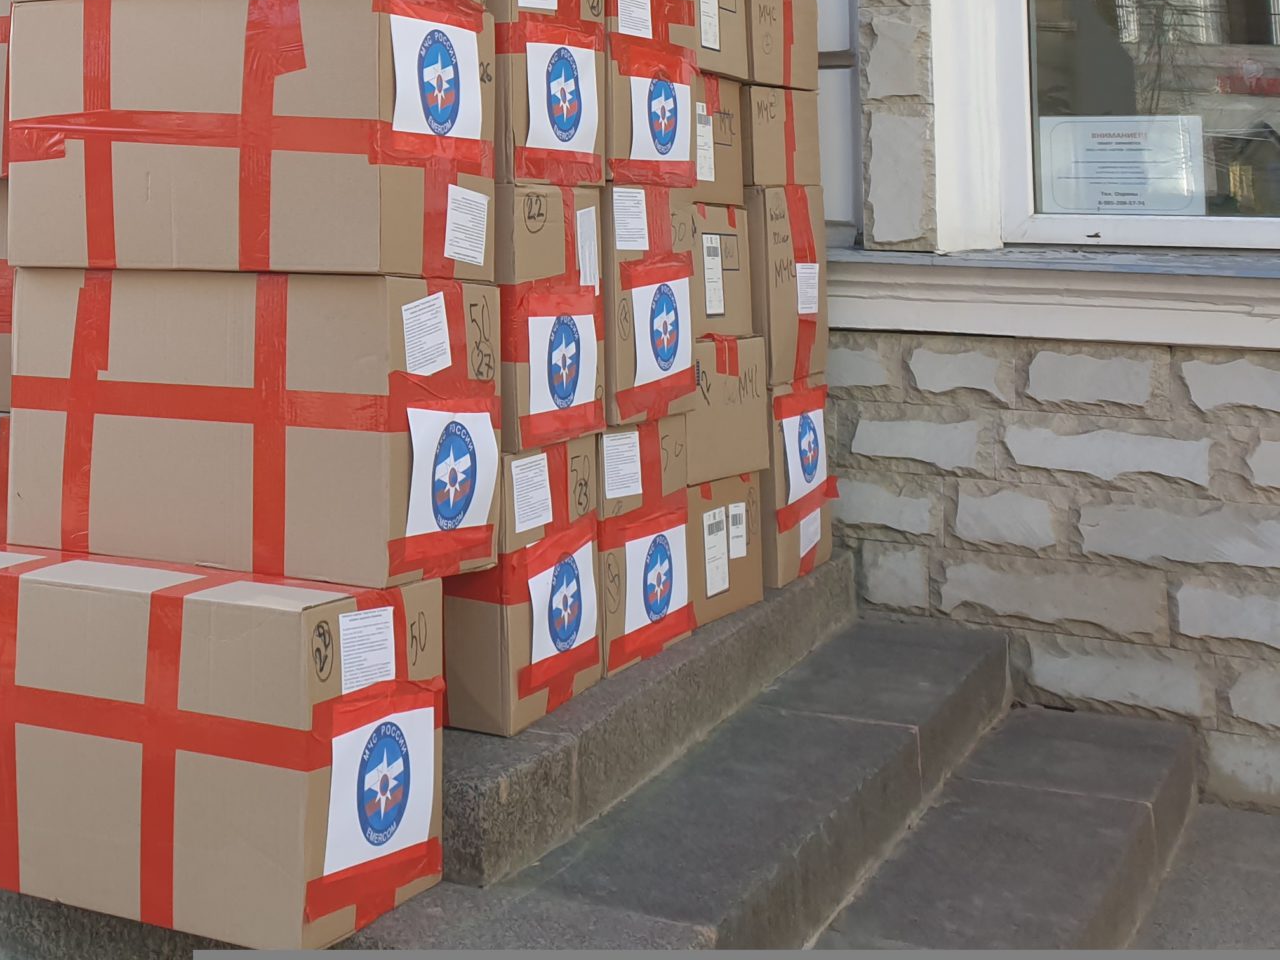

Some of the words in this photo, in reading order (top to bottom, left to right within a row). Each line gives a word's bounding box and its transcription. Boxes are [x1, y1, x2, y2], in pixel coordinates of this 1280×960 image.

[758, 3, 777, 25] МЧС
[420, 35, 433, 58] МЧС
[435, 31, 457, 65] РОССИИ
[480, 61, 493, 84] 26
[547, 53, 558, 73] МЧС
[561, 49, 579, 77] РОССИИ
[756, 100, 776, 120] МЧС
[428, 115, 452, 135] EMERCOM
[554, 124, 576, 142] EMERCOM
[524, 193, 546, 225] 22
[774, 257, 796, 288] МЧС
[470, 295, 491, 350] 50
[549, 319, 559, 341] МЧС
[474, 347, 495, 381] 27
[553, 391, 575, 410] EMERCOM
[449, 424, 474, 452] РОССИИ
[661, 434, 683, 473] 50
[437, 511, 464, 530] EMERCOM
[410, 611, 428, 667] 50
[363, 735, 378, 762] МЧС
[381, 725, 408, 755] РОССИИ
[366, 826, 398, 844] EMERCOM
